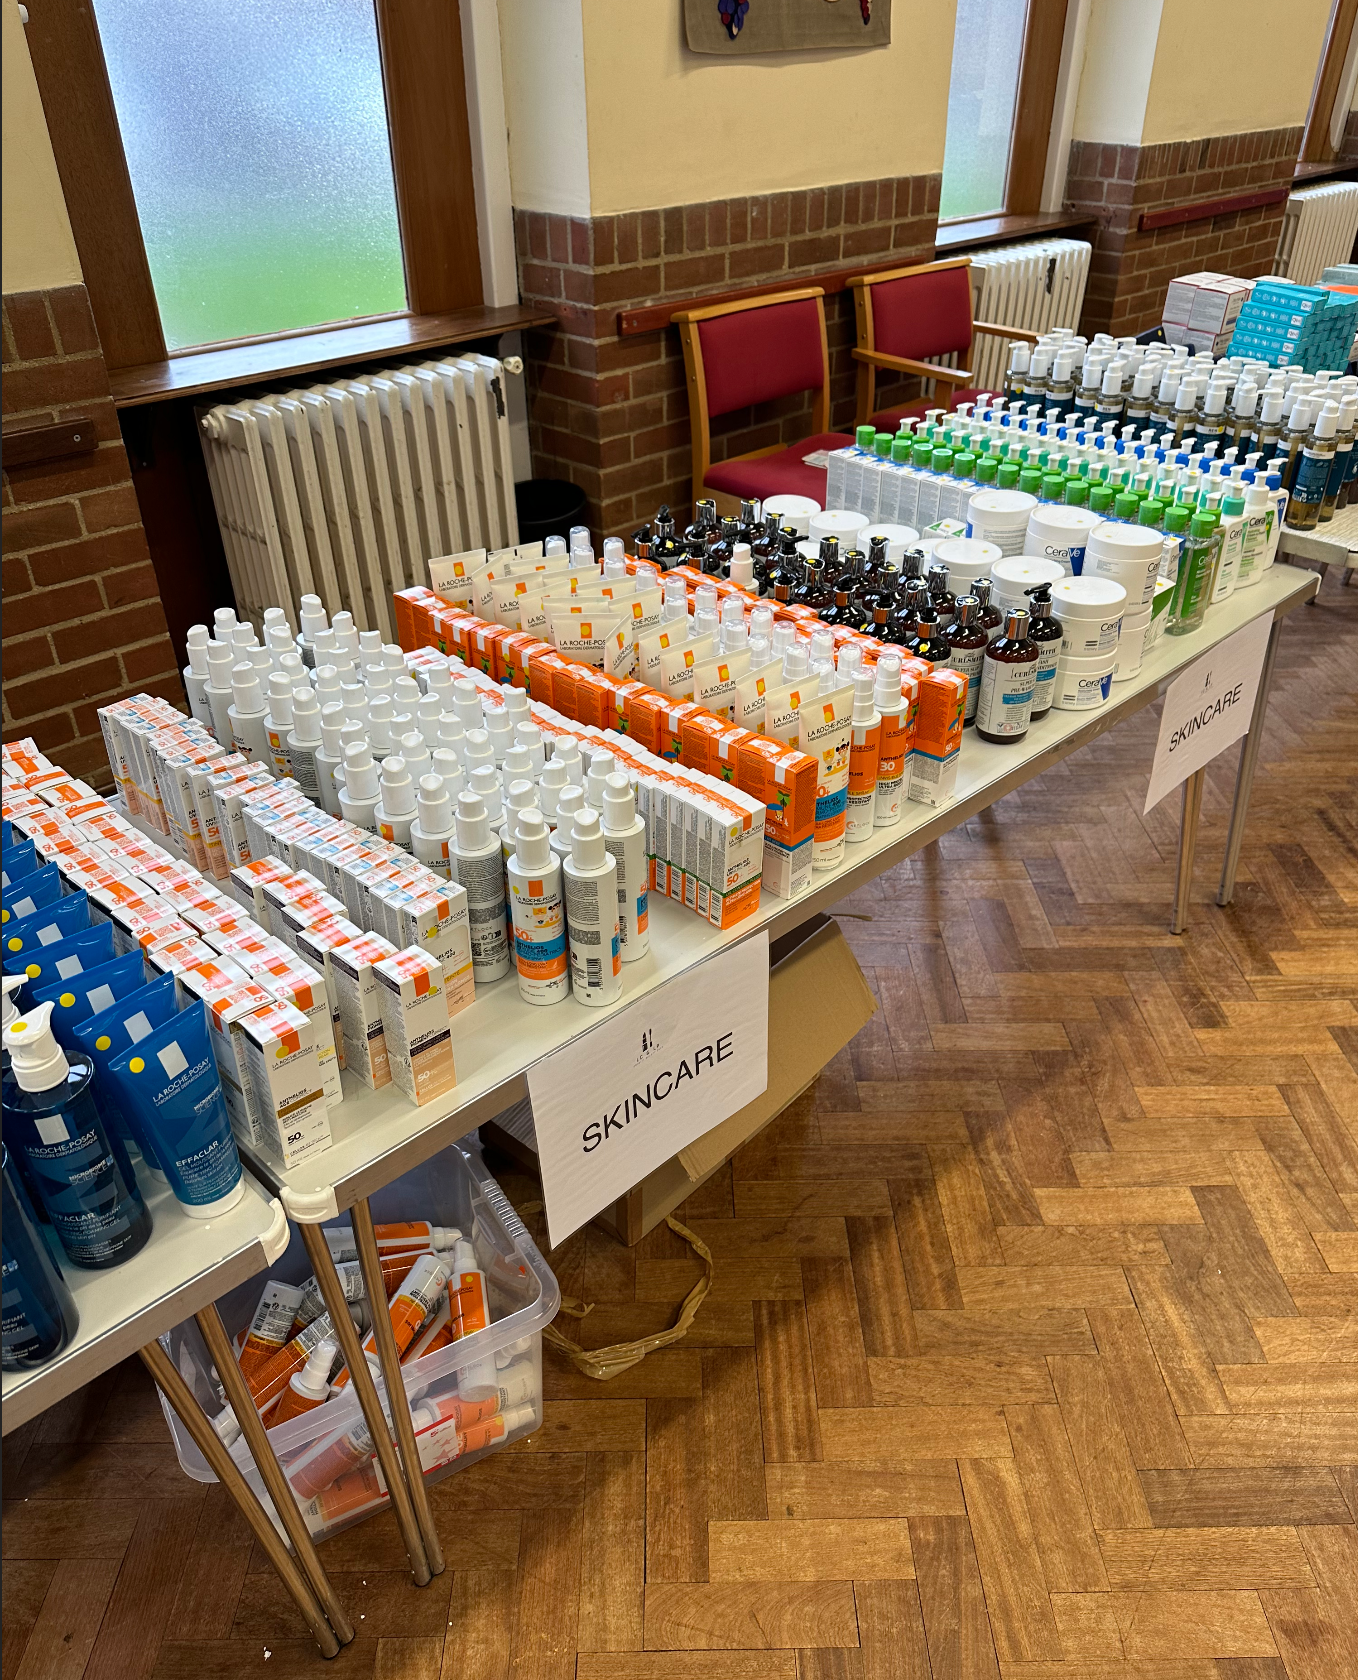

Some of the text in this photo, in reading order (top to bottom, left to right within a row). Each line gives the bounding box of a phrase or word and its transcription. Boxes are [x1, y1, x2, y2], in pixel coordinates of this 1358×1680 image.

[1249, 514, 1274, 527] CeraVe
[1045, 545, 1080, 557] CeraVe
[668, 674, 676, 682] LA
[1078, 677, 1108, 688] CeraVe
[700, 687, 709, 696] LA
[743, 704, 751, 712] LA
[773, 717, 782, 725] LA
[816, 715, 852, 735] ROCHE-POSAY
[1169, 683, 1243, 752] SKINCARE
[880, 761, 895, 771] 30
[816, 796, 839, 806] THELIOS
[433, 907, 467, 930] OCHE-POSAY
[514, 927, 534, 942] 50+
[374, 1053, 386, 1065] 50
[152, 1056, 210, 1103] LA ROCHE-POSAY
[155, 1063, 212, 1107] LABORATOIRE DERMATOLOGIQUE
[582, 1032, 733, 1153] SKINCARE
[34, 1128, 96, 1154] ROCHE-POSAY
[287, 1131, 302, 1145] 50
[55, 1134, 98, 1158] DERMATOLOGIQUE
[175, 1140, 219, 1167] EFFACLAR
[68, 1159, 106, 1180] MICROBIOME
[69, 1164, 108, 1186] SCIENCE
[92, 1204, 122, 1223] PURIFIANT
[102, 1216, 115, 1226] peau
